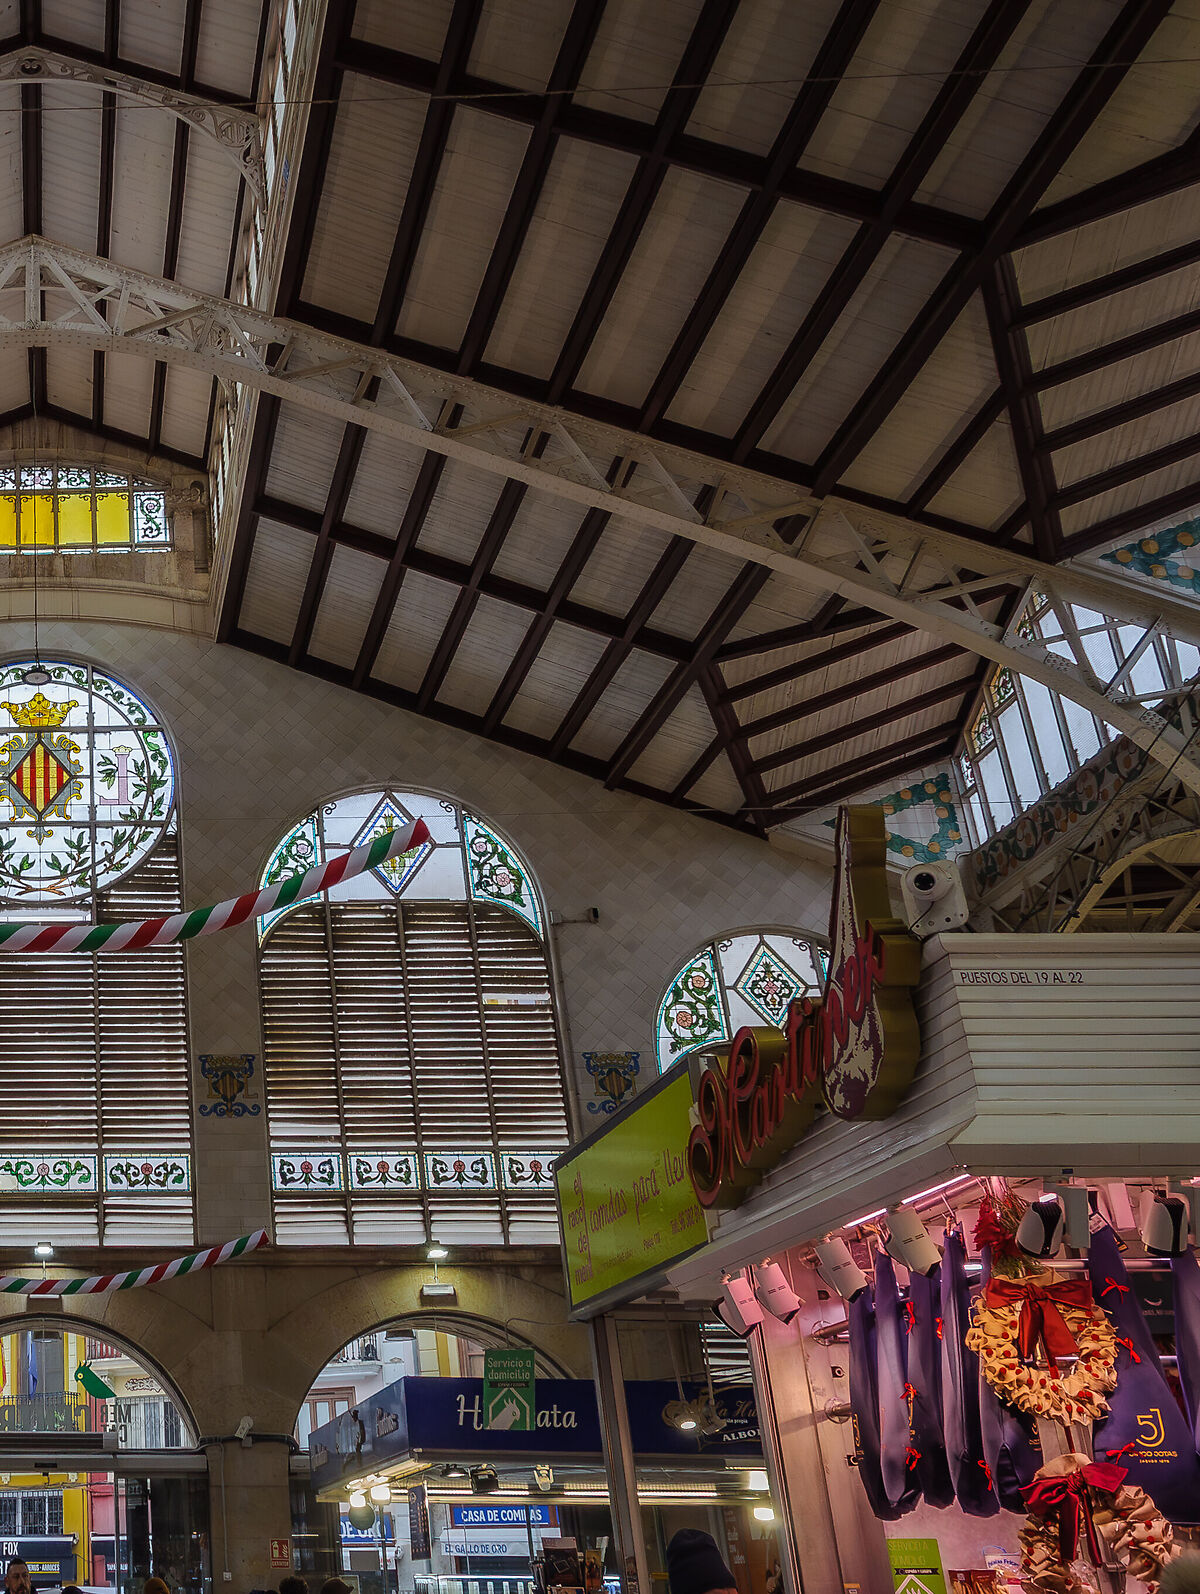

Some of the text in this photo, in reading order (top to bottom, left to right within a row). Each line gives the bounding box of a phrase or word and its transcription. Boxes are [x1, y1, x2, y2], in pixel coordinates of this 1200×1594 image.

[960, 971, 1084, 983] PUESTOS DEL 19 AL 22
[589, 1187, 628, 1232] comidas
[633, 1168, 660, 1225] para
[487, 1357, 524, 1368] Servicio
[488, 1369, 530, 1380] domicilio
[456, 1394, 578, 1430] Hata
[461, 1509, 486, 1522] CASA
[487, 1509, 500, 1521] DE
[2, 1542, 19, 1556] FOX
[481, 1544, 490, 1553] DE
[491, 1544, 507, 1554] ORO
